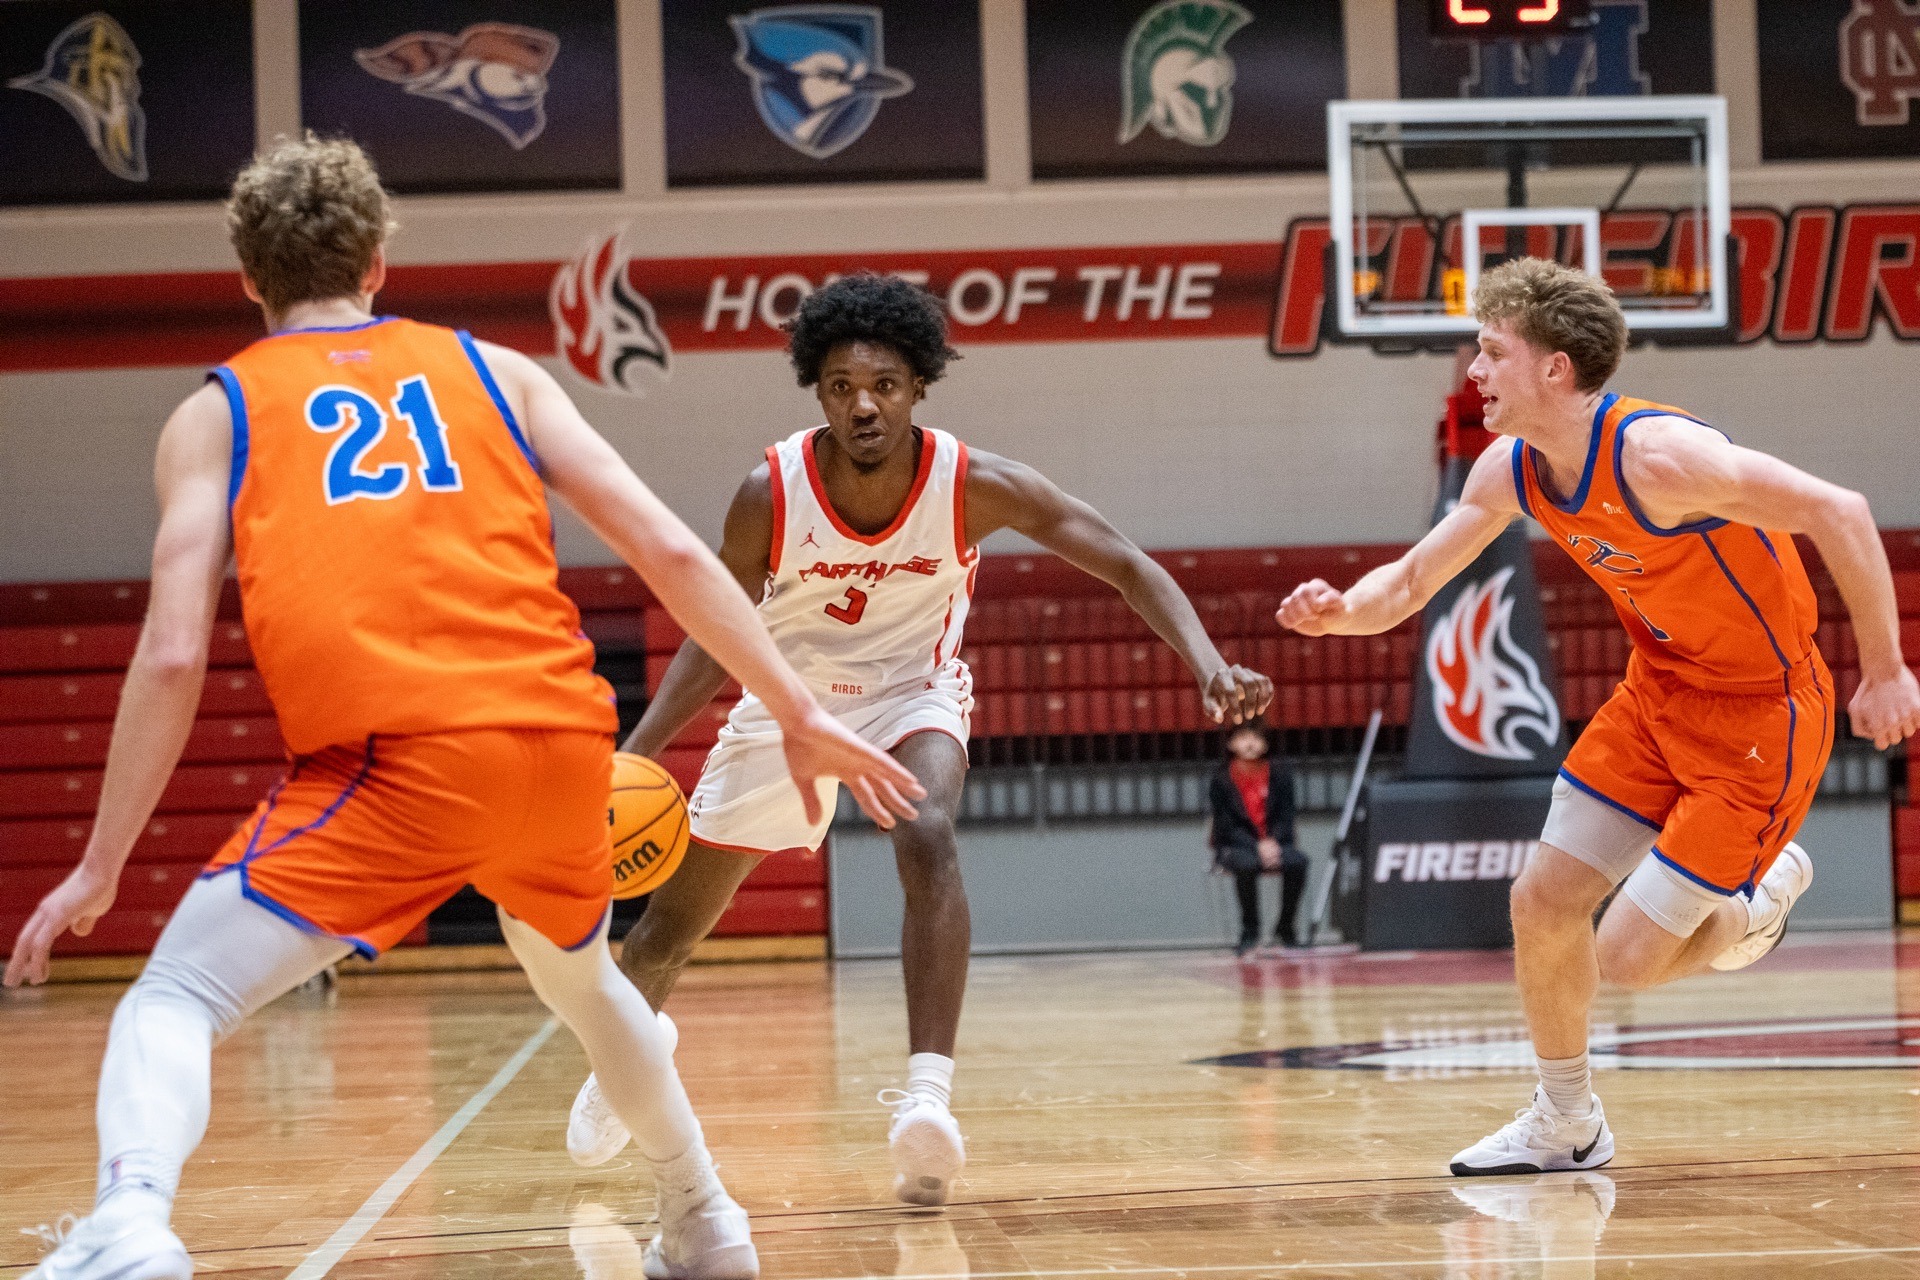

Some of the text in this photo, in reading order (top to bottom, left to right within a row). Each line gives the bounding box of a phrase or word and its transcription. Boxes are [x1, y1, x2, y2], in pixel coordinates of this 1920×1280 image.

[702, 262, 1221, 332] HO OF THE
[304, 373, 463, 506] 21
[831, 683, 863, 695] BIRDS
